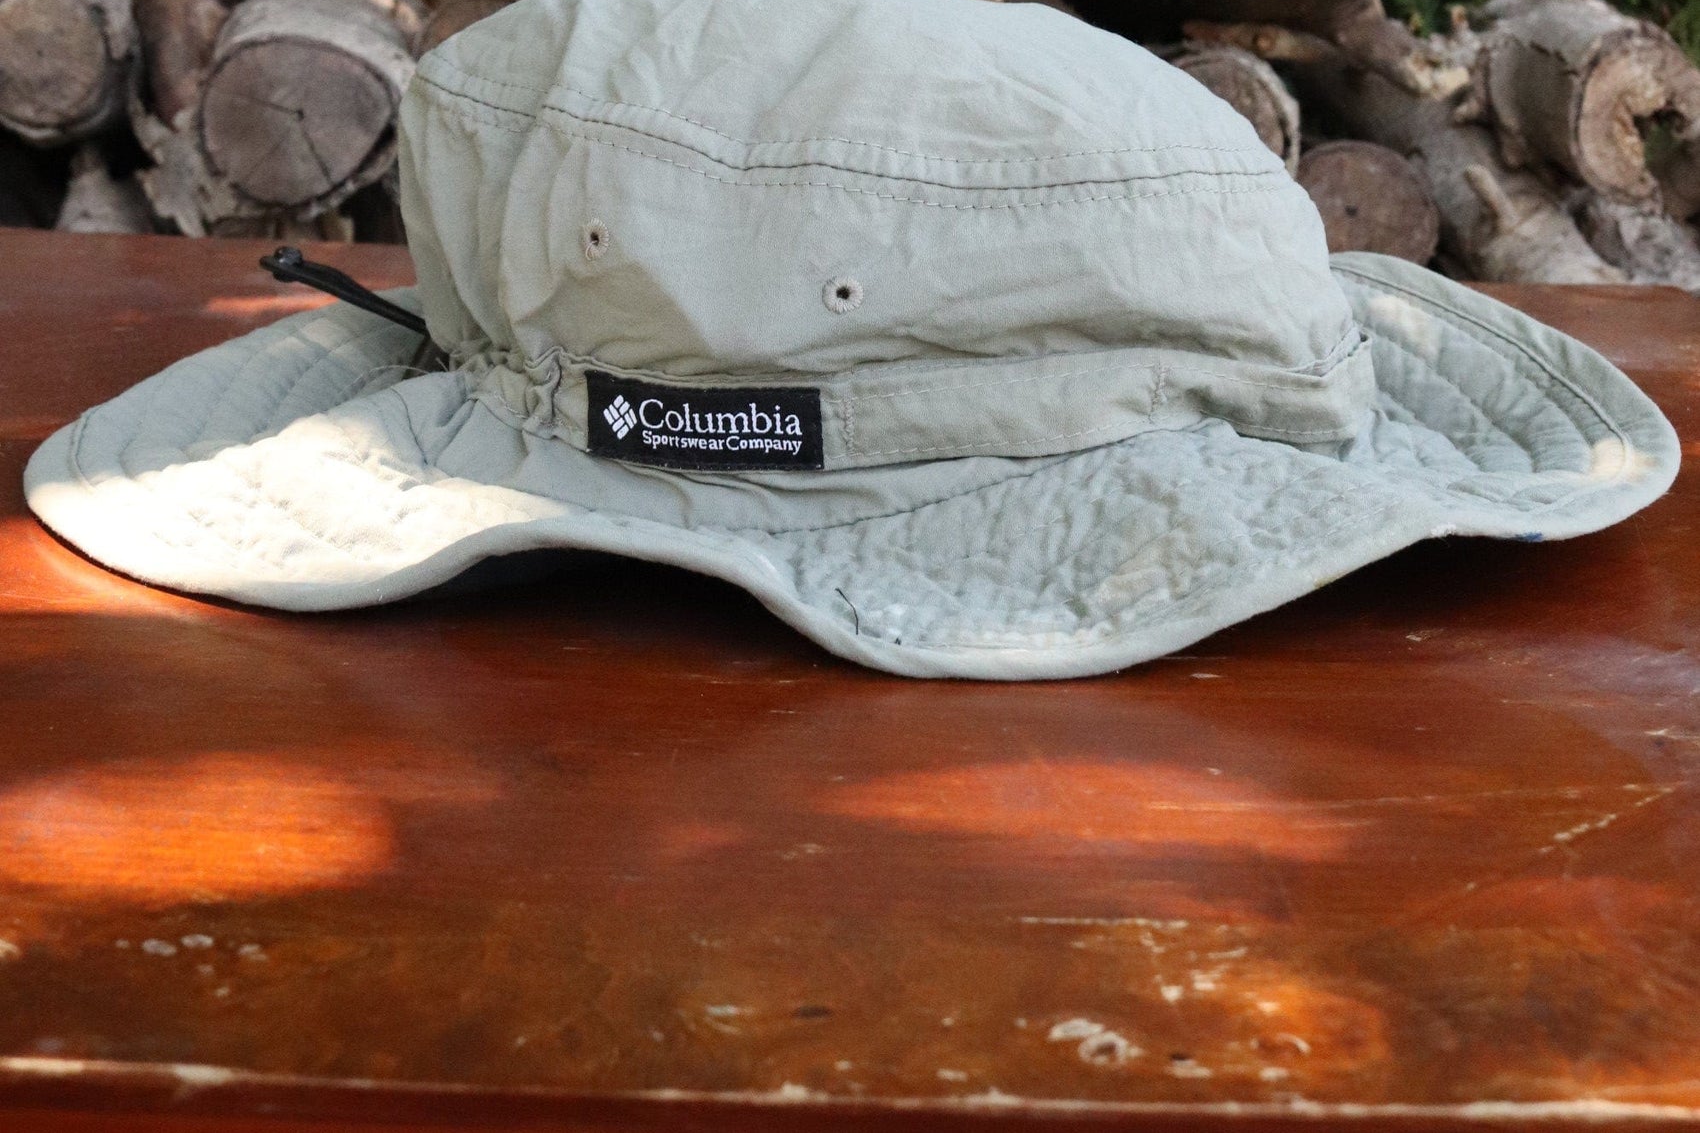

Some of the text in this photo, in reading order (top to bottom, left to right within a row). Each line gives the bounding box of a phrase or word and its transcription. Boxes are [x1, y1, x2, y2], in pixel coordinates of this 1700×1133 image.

[639, 399, 803, 436] Columbia
[642, 430, 802, 455] Sportswear Company
